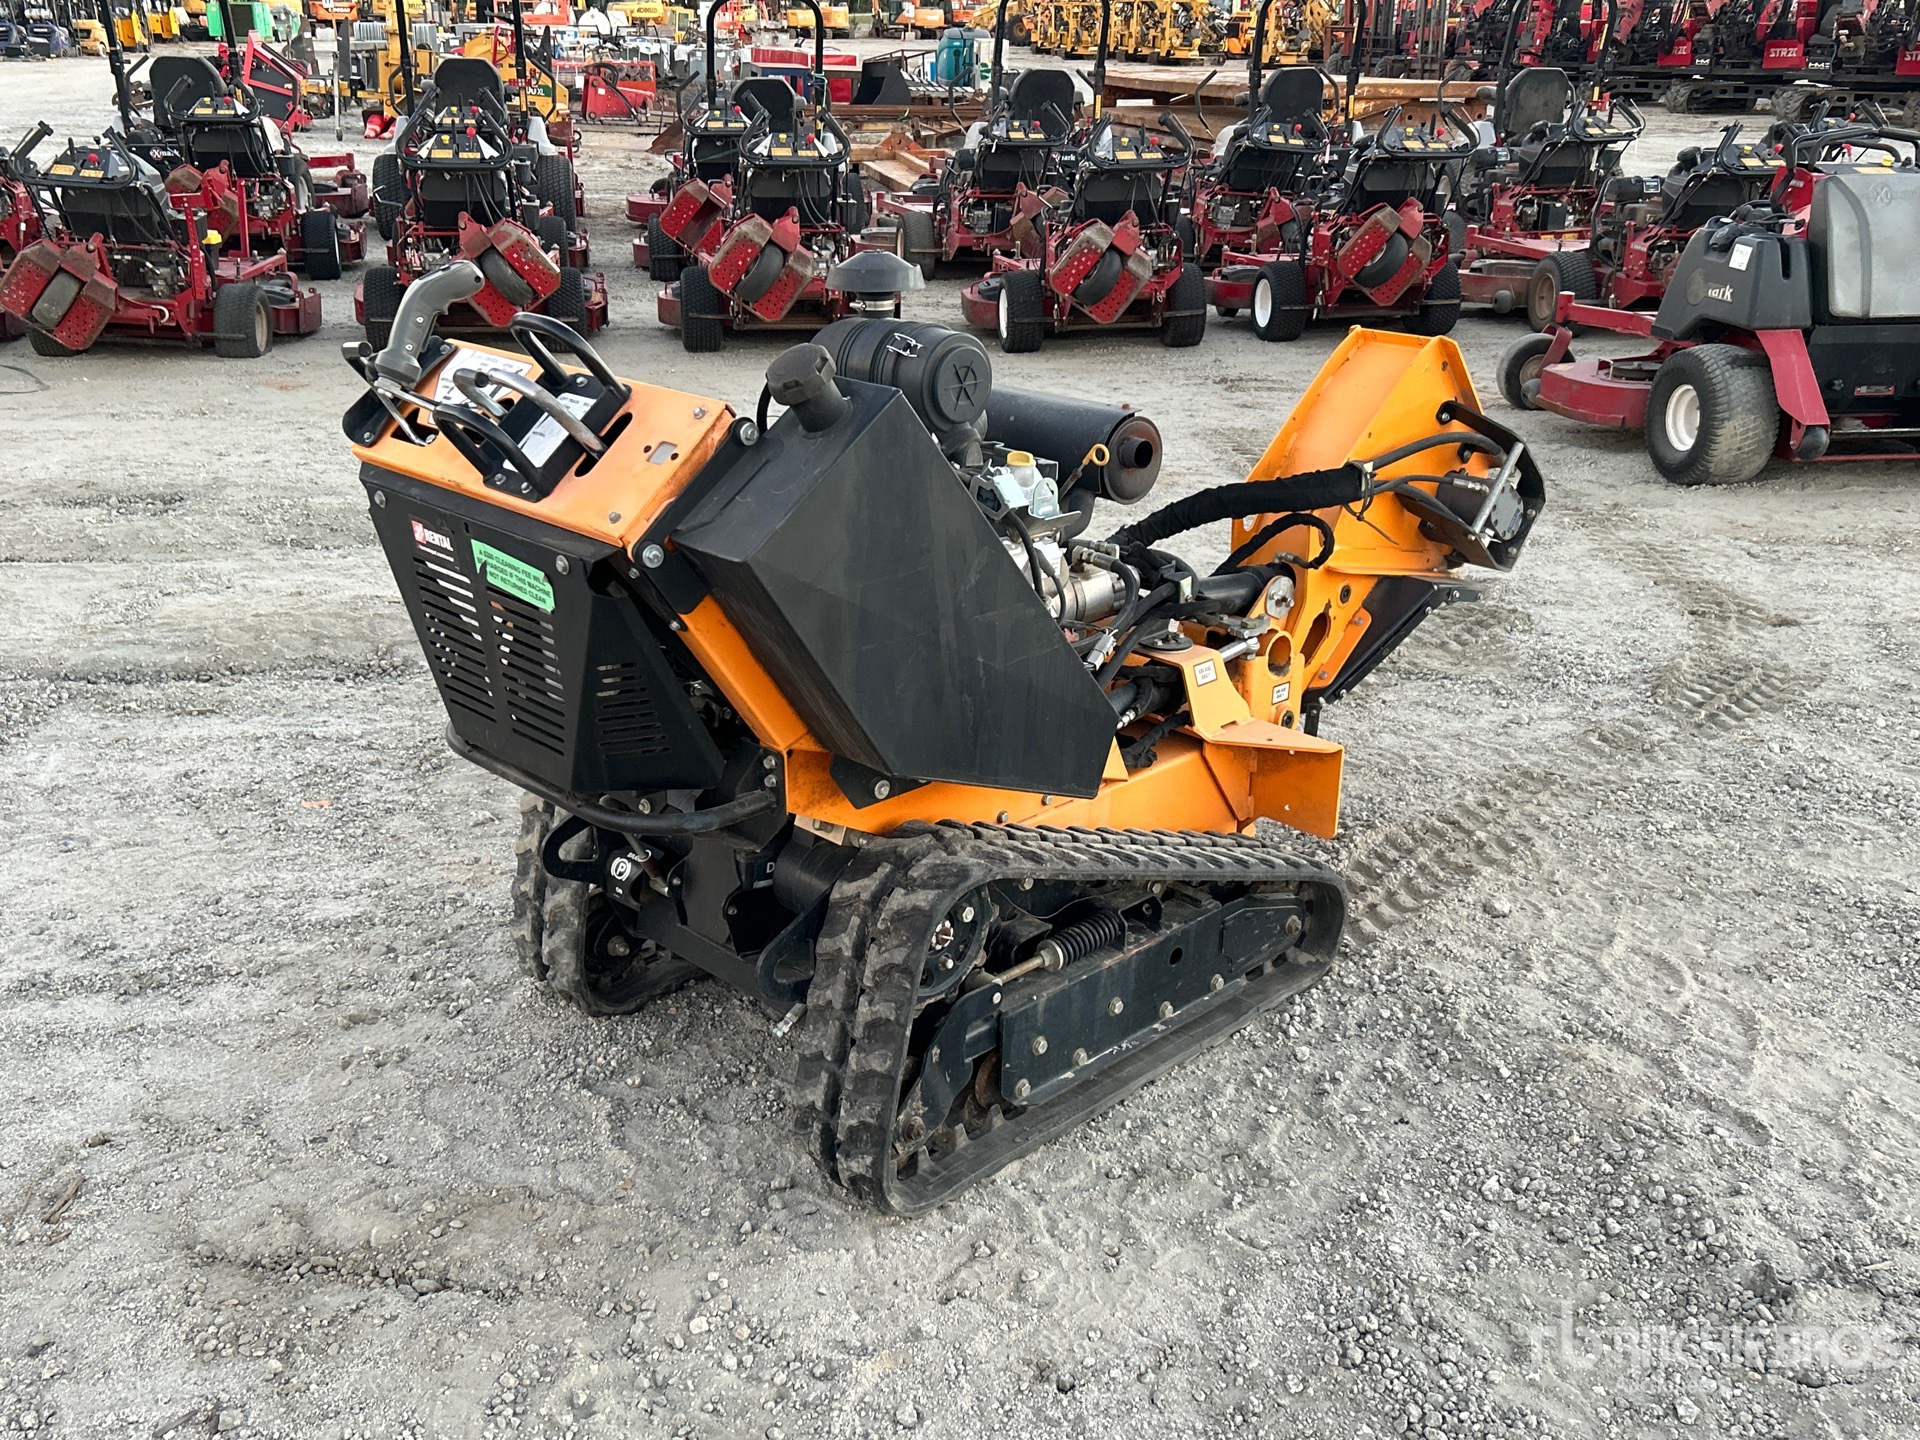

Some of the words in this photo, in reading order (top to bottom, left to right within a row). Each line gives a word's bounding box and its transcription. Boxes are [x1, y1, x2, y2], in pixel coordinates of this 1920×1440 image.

[149, 147, 180, 160] eXmak
[424, 528, 454, 551] RENTAL
[494, 555, 521, 574] CLEANING
[521, 569, 532, 580] FEE
[500, 575, 527, 595] RETURNED
[528, 590, 546, 605] CLEAN
[514, 574, 527, 586] THIS
[526, 580, 551, 599] MACHINE
